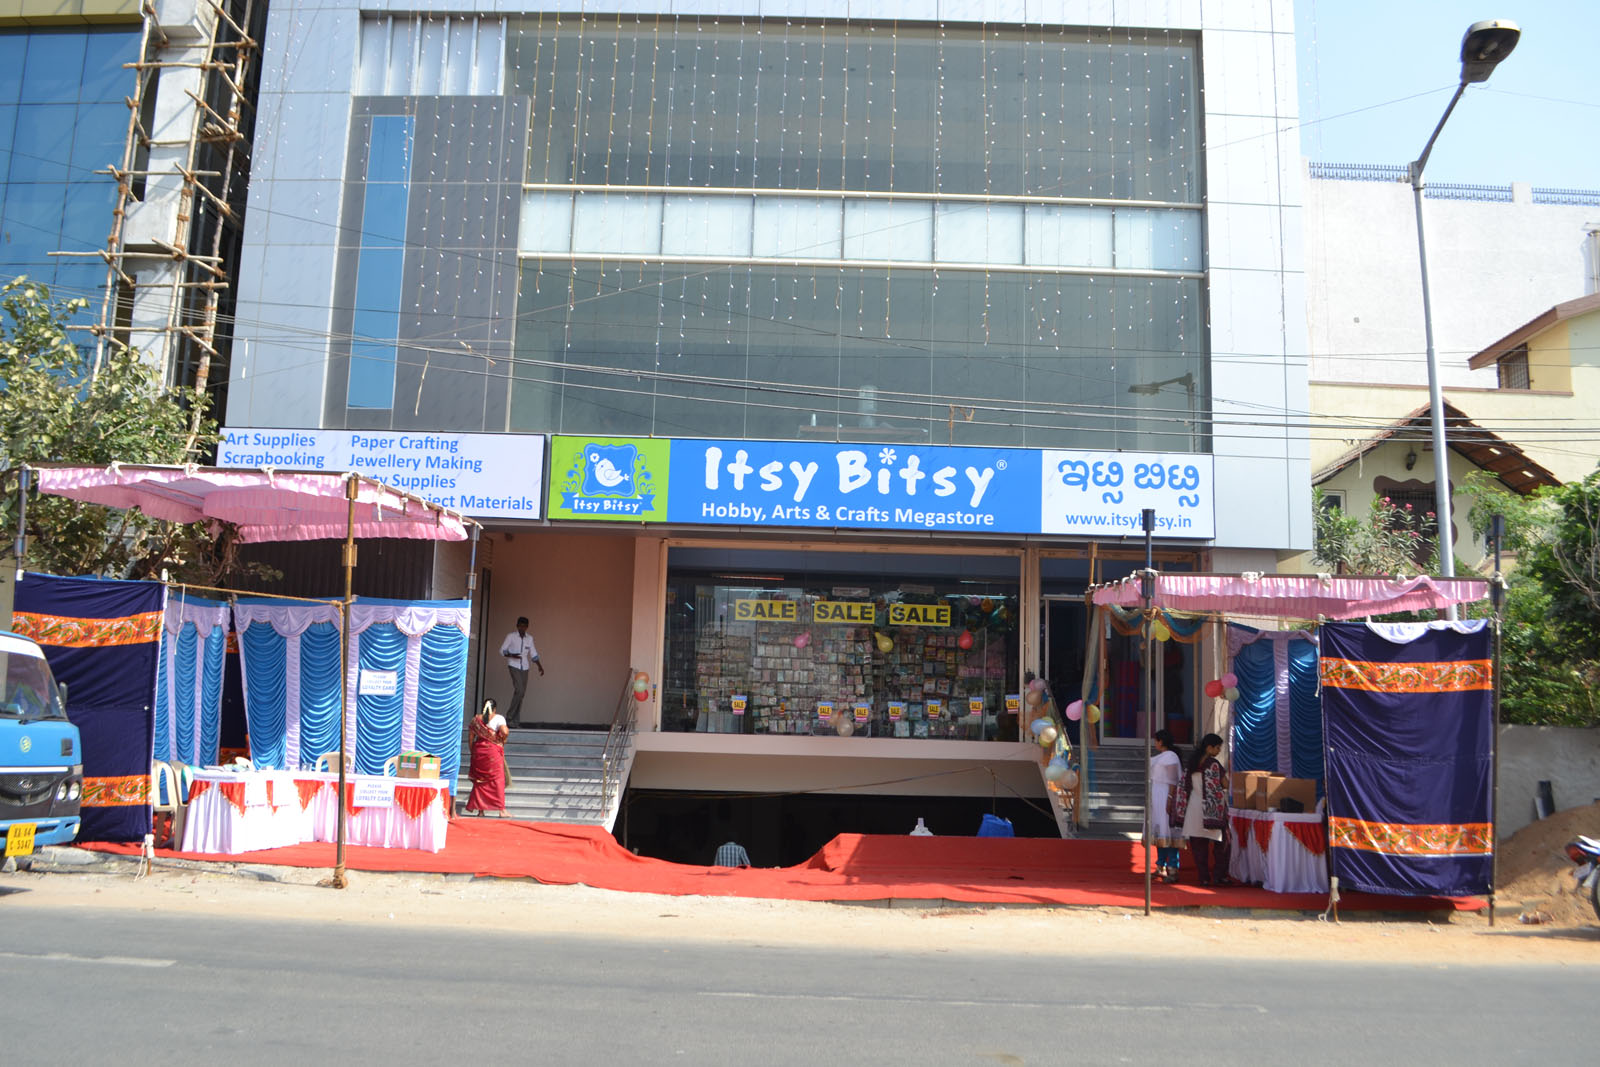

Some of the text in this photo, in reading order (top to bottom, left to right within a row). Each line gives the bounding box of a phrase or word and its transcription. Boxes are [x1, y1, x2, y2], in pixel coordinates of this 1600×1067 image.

[224, 432, 316, 449] Art Supplies
[351, 434, 459, 453] Paper Crafting
[223, 450, 325, 469] Scrapbooking
[349, 453, 482, 473] Jewellery Making
[391, 473, 456, 491] Supplies
[702, 446, 818, 503] Itsy
[459, 494, 533, 511] Materials
[573, 498, 640, 514] Itsy Bitsy
[701, 502, 995, 528] Hobby, Arts & Crafts Megastore
[737, 602, 795, 619] SALE
[815, 604, 873, 621] SALE
[891, 606, 949, 624] SALE
